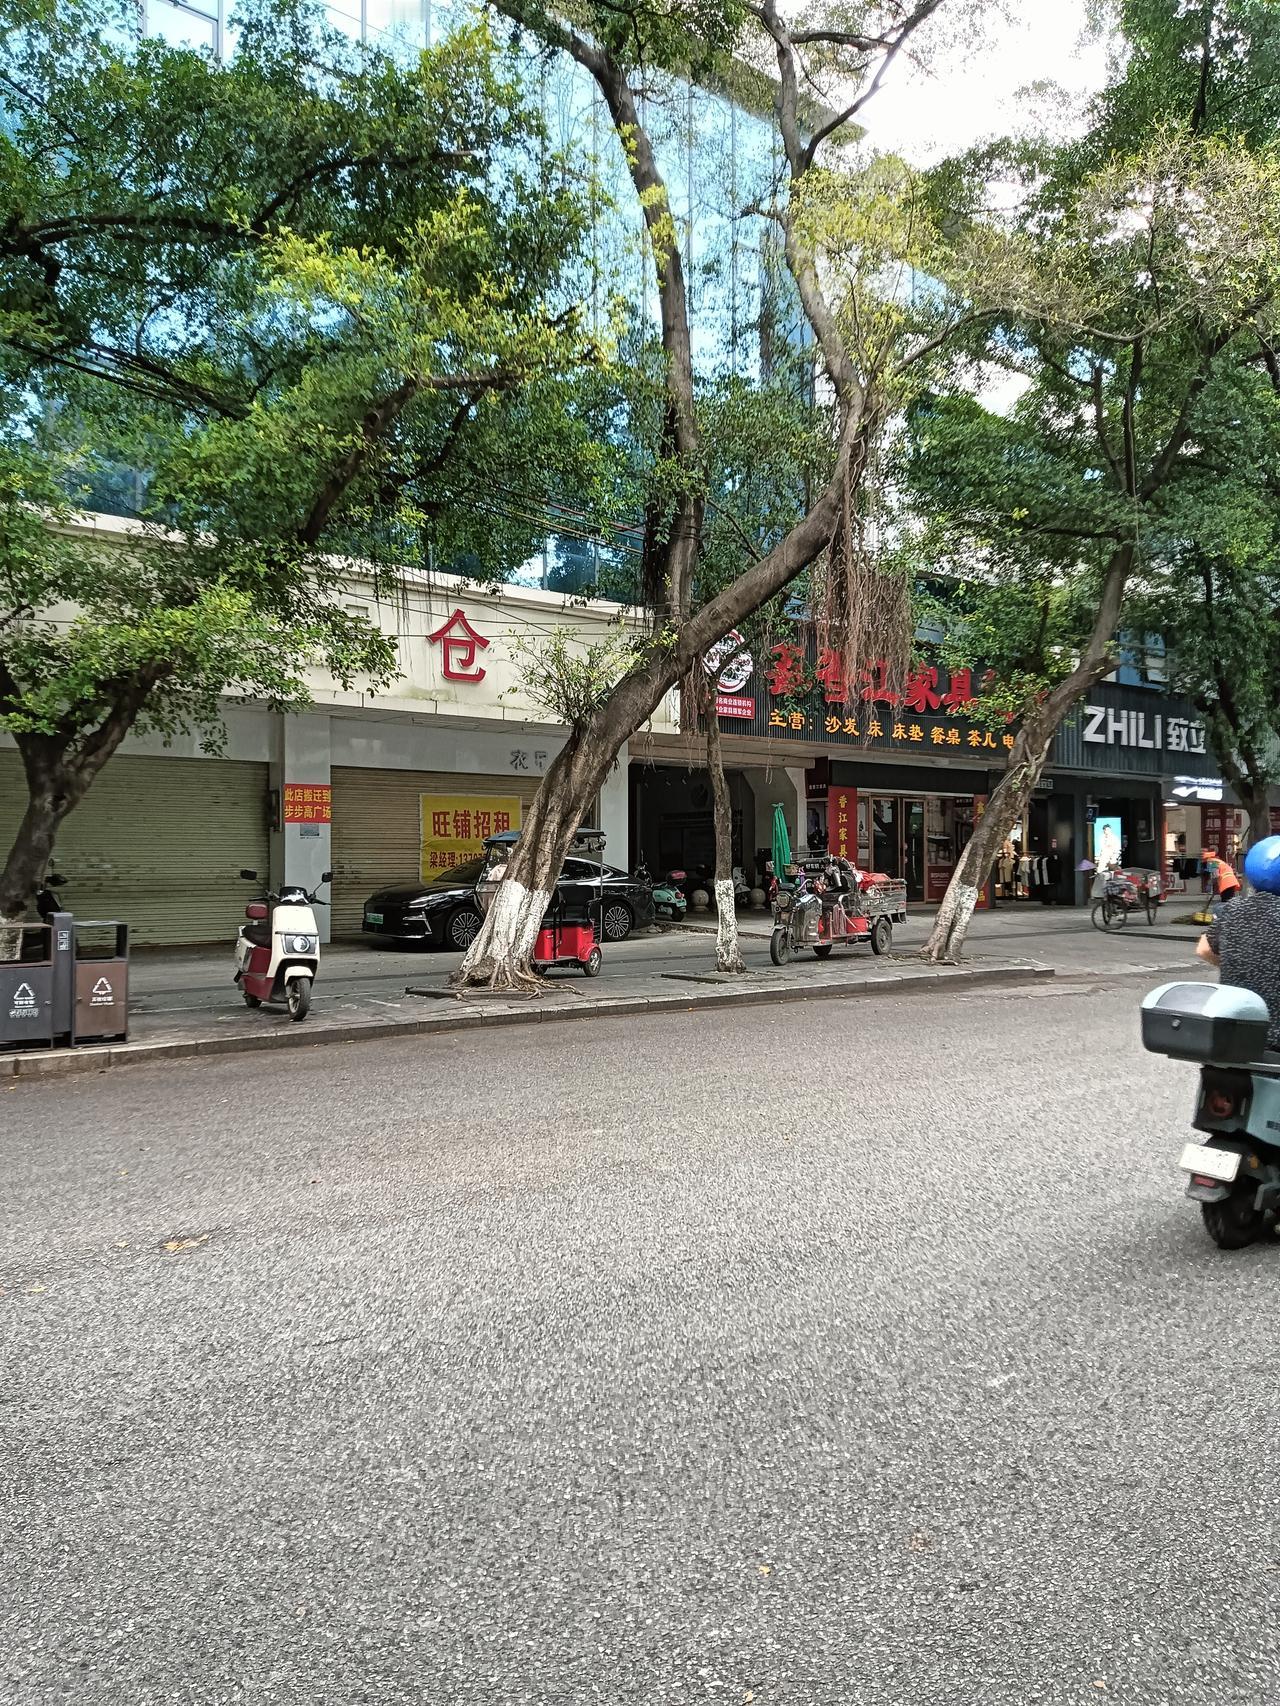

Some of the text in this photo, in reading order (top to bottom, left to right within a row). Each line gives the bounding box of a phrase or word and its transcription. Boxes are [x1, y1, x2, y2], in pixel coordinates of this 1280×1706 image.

[426, 608, 490, 682] 仓
[825, 716, 860, 736] 沙发
[867, 721, 884, 737] 床
[892, 723, 924, 742] 床垫
[930, 726, 961, 745] 餐桌
[967, 729, 997, 749] 茶几
[1083, 705, 1162, 749] ZHILI
[285, 788, 331, 802] 此店搬迁到
[285, 804, 331, 818] 步步高广场
[432, 810, 510, 839] 旺铺招租
[838, 795, 848, 857] 香江家具
